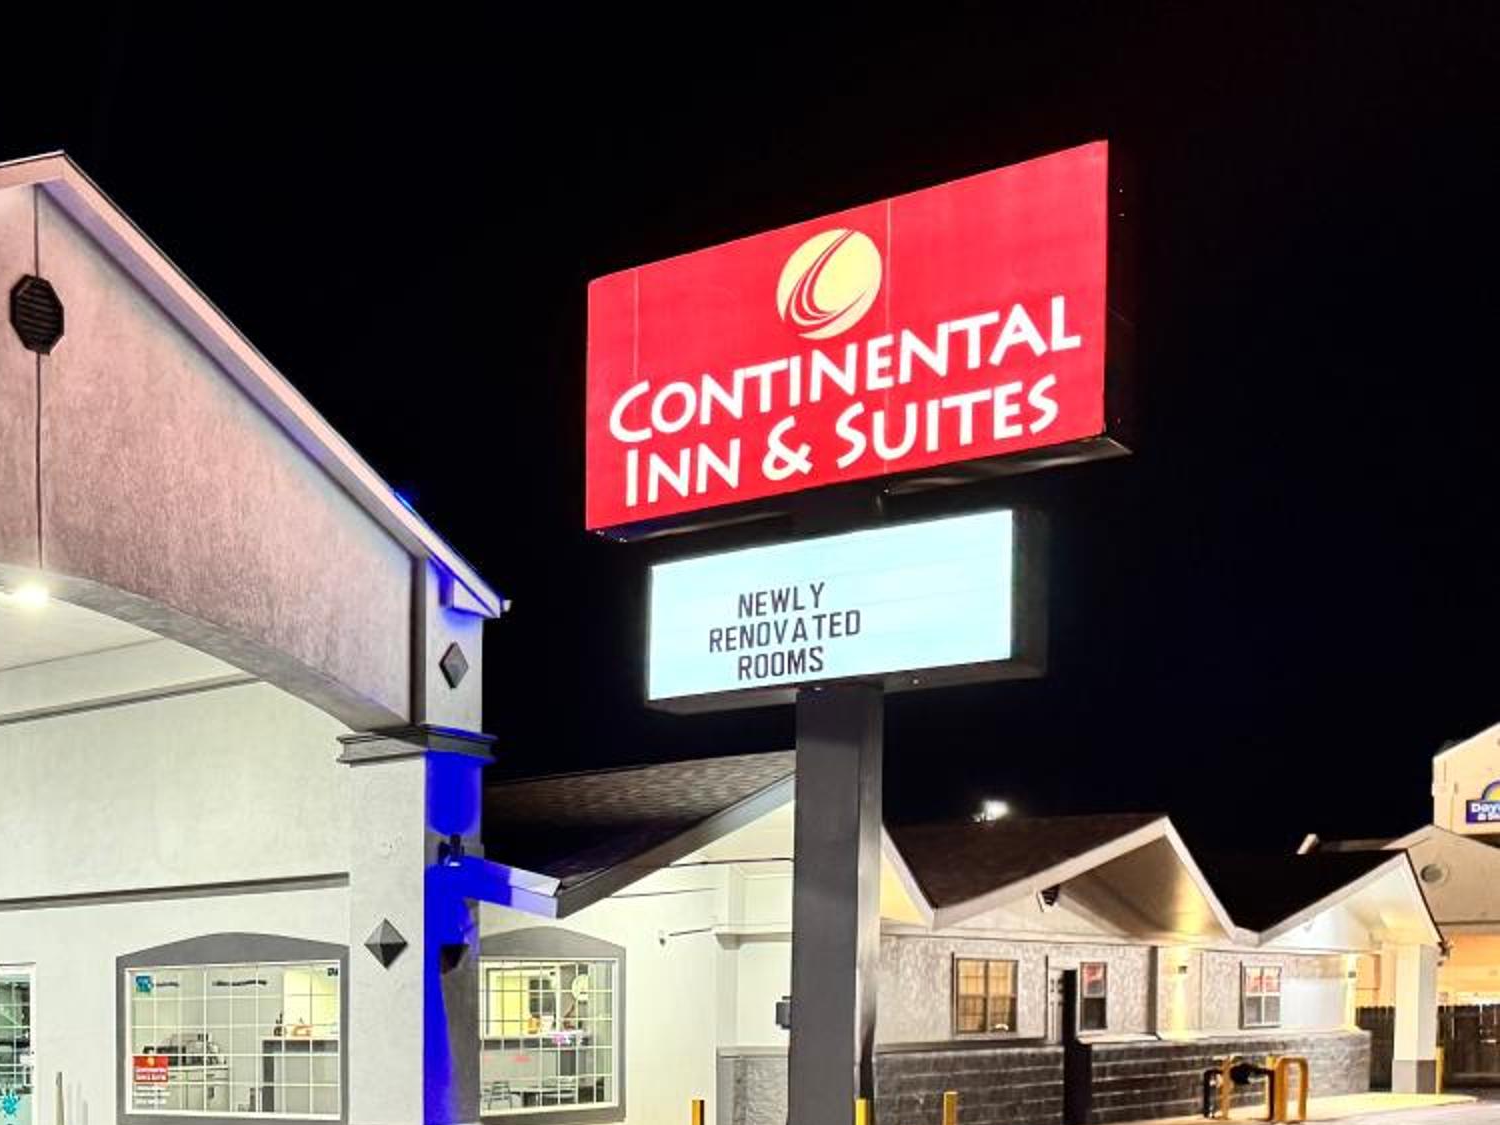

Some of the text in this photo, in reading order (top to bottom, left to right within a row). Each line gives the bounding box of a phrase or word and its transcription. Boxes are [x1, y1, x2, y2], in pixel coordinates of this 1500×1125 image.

[609, 296, 1081, 443] CONTINENTAL
[624, 374, 1059, 507] INN & SUITES
[738, 581, 825, 619] NEWLY
[708, 608, 862, 653] RENOVATED
[738, 646, 825, 681] ROOMS
